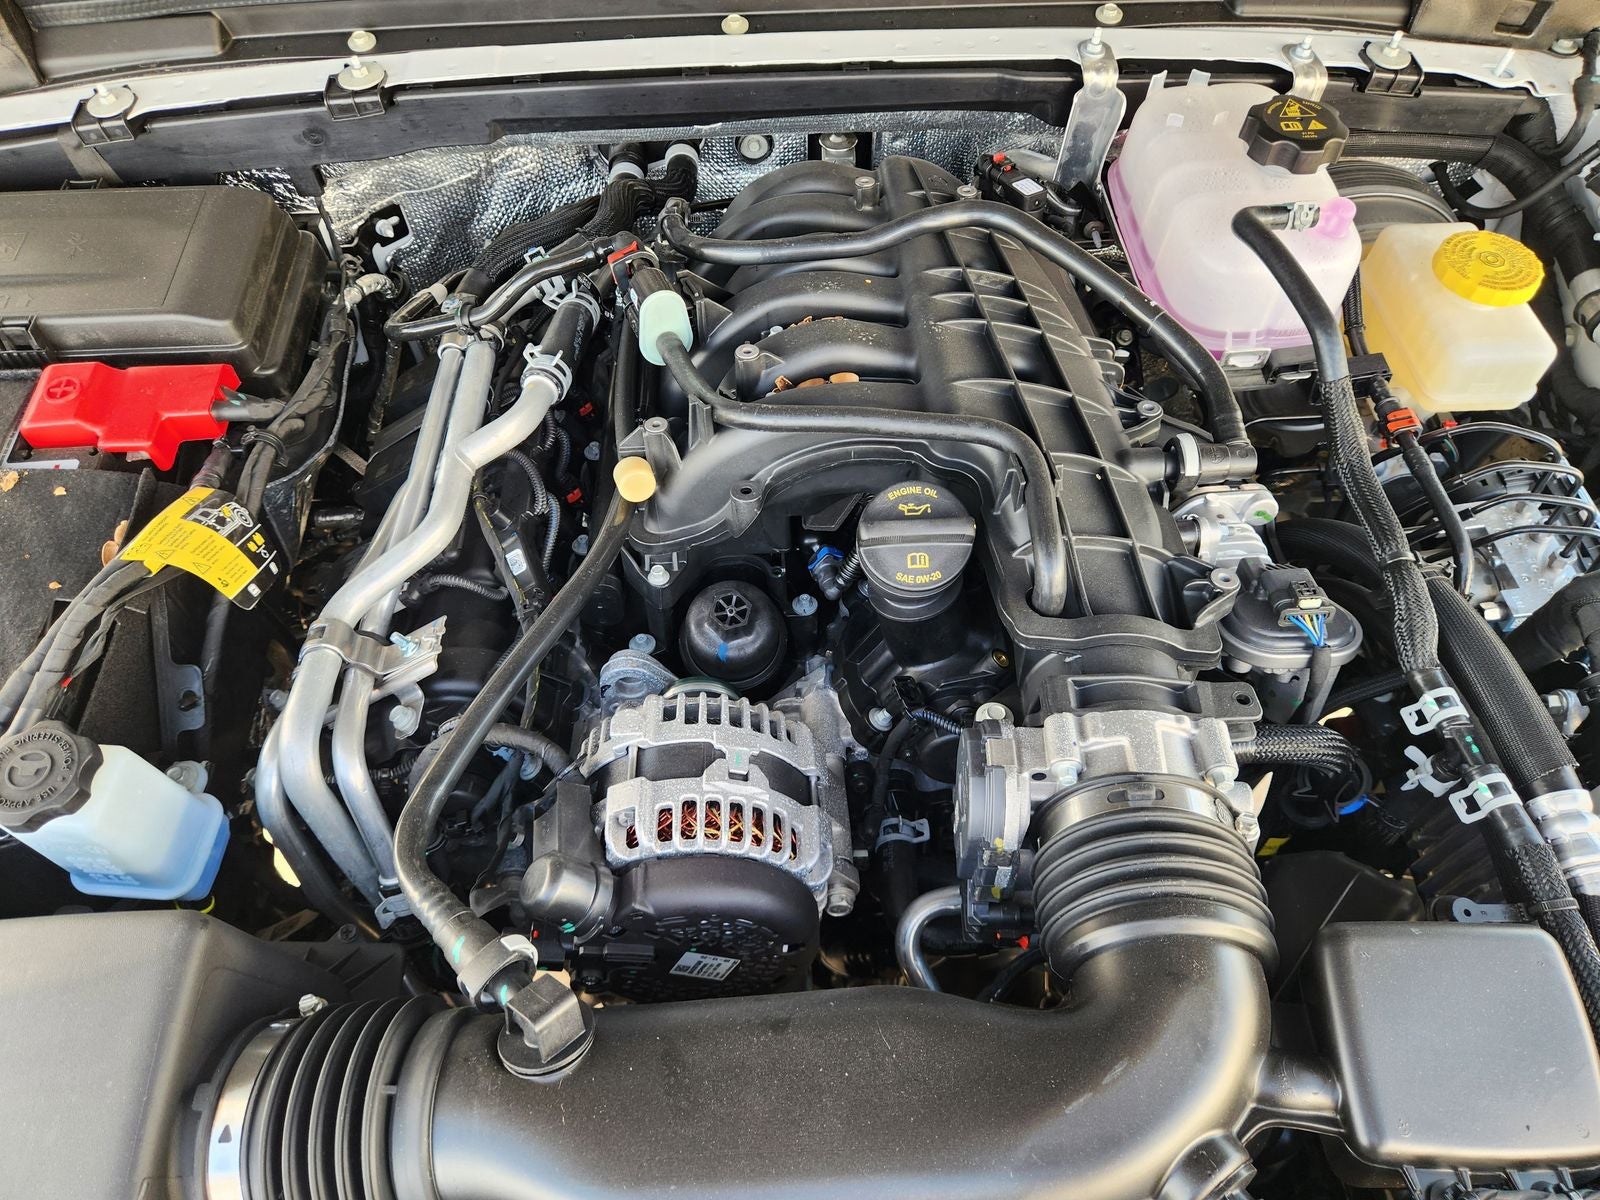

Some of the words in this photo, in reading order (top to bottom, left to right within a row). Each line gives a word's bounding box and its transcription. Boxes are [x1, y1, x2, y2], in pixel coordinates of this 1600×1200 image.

[888, 486, 921, 500] ENGINE
[924, 487, 938, 498] OIL
[895, 572, 914, 583] SAE
[916, 570, 941, 583] 0W-20
[14, 732, 62, 747] STEERING
[57, 739, 73, 771] POWER
[36, 785, 57, 802] USE
